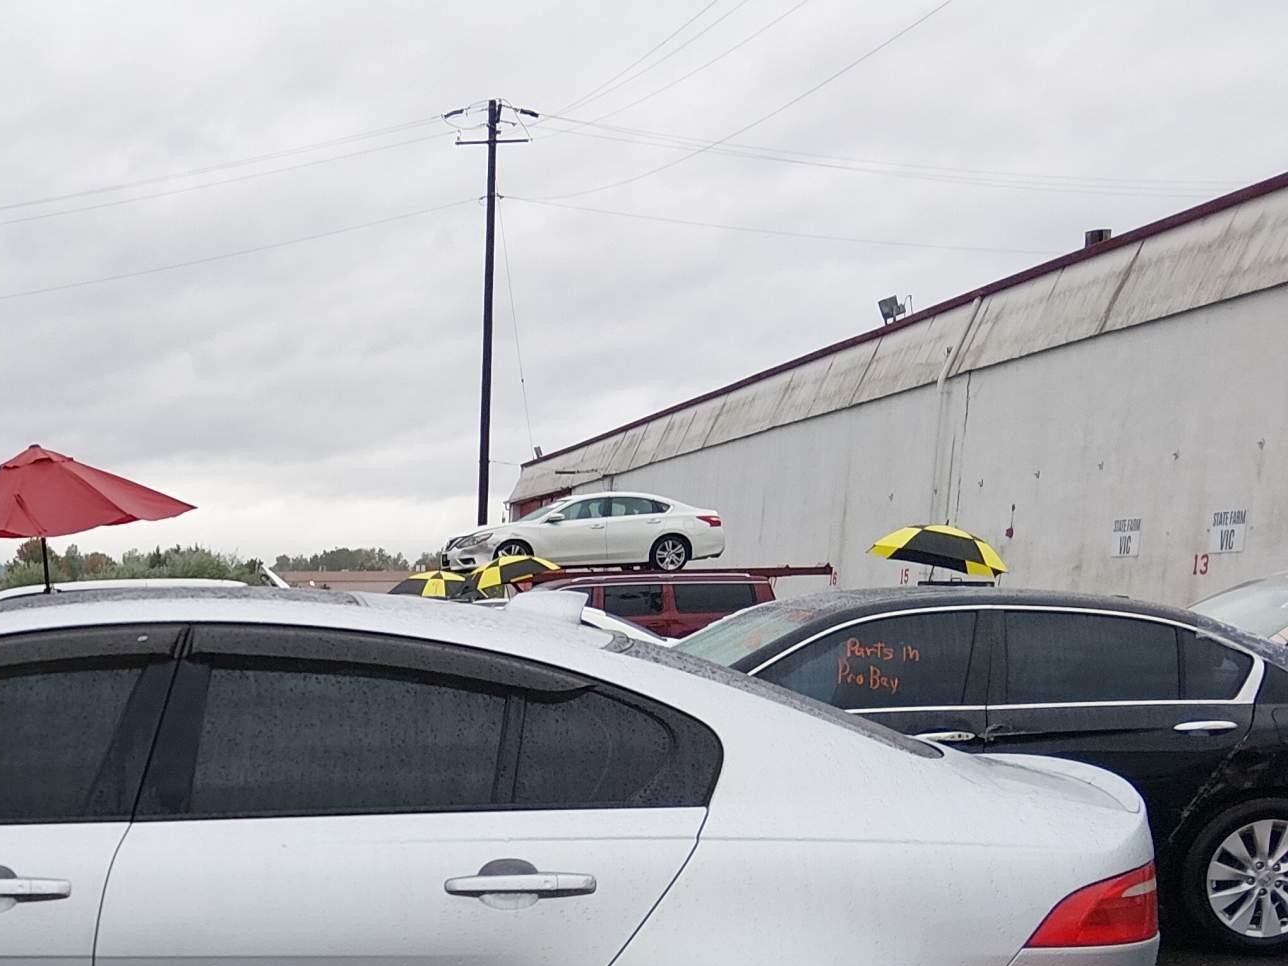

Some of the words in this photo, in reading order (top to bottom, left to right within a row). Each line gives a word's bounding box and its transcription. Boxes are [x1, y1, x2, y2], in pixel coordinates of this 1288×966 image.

[1212, 511, 1230, 527] STATE
[1230, 509, 1247, 525] FARM
[1119, 535, 1132, 555] VIC
[1220, 529, 1235, 551] VIC
[1192, 553, 1210, 576] 13
[900, 568, 910, 585] 15
[846, 638, 894, 660] Parts
[902, 643, 920, 662] in
[837, 658, 865, 685] Pro
[870, 665, 900, 693] Bay
